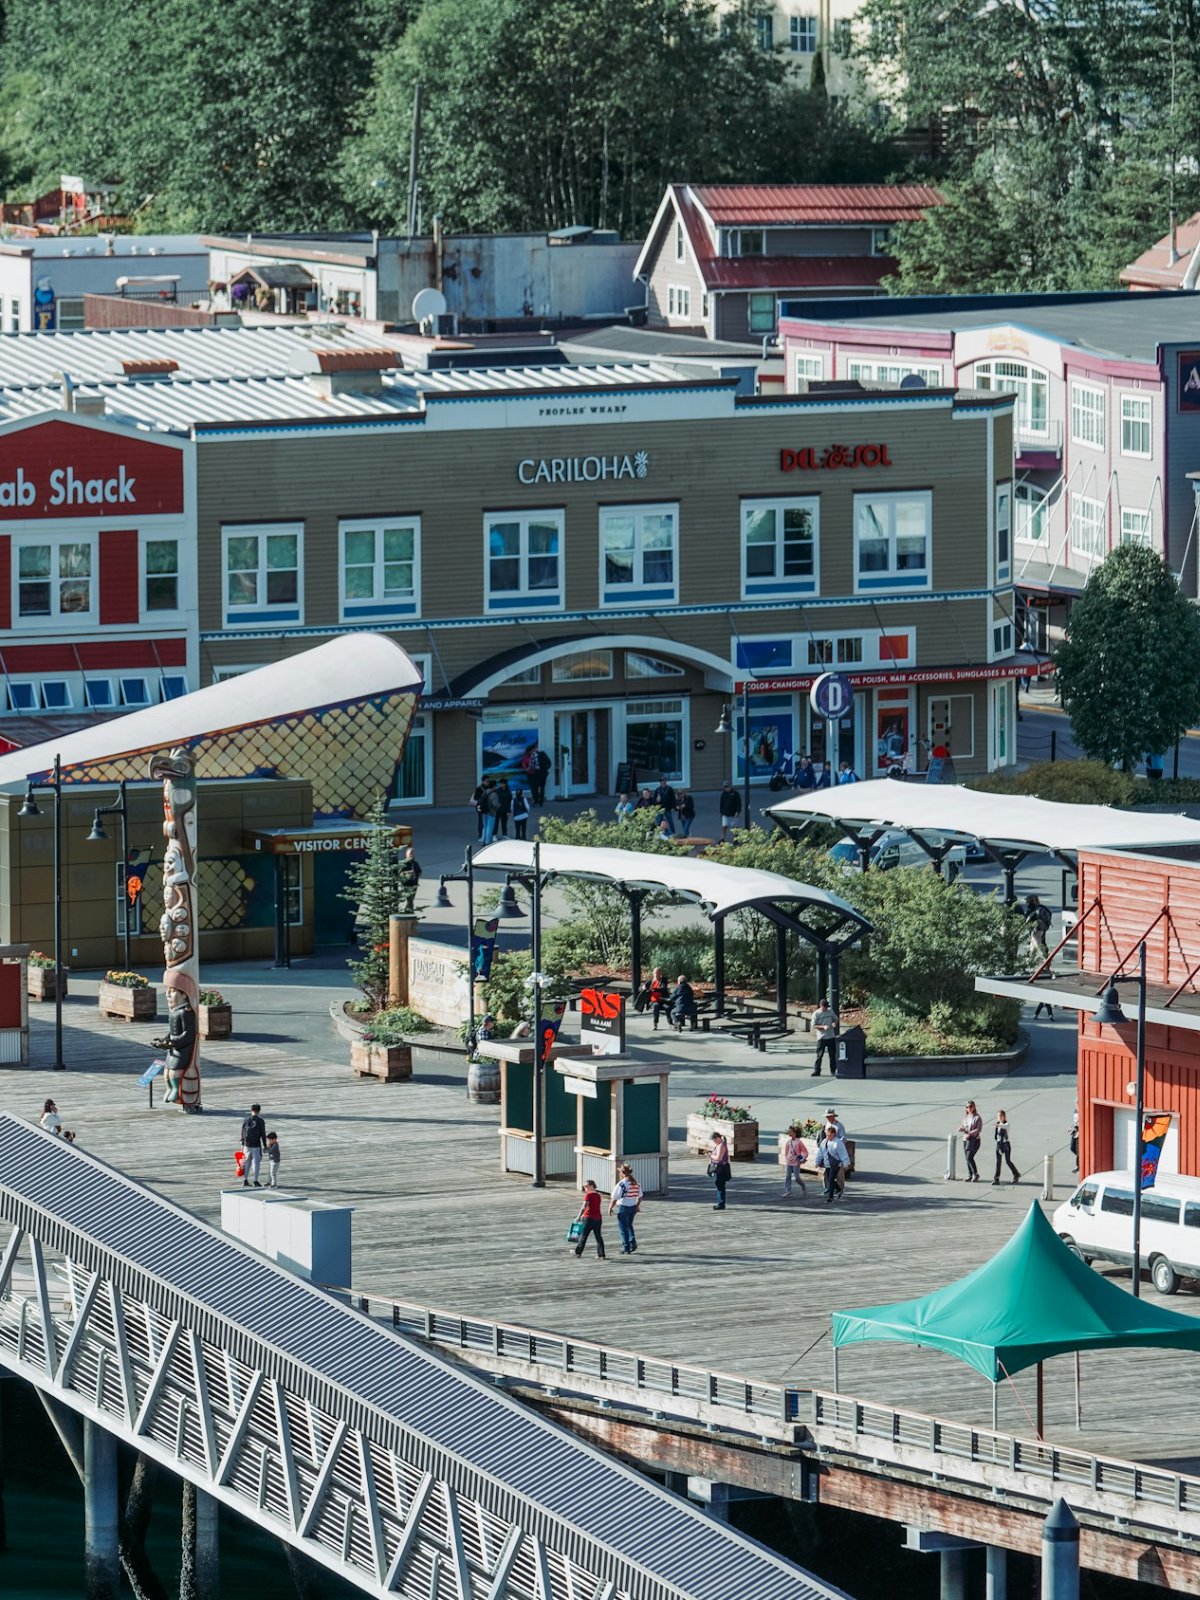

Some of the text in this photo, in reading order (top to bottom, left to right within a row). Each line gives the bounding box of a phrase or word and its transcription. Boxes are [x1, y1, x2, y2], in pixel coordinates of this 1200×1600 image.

[590, 405, 627, 413] WHARF
[780, 443, 893, 472] DEL SOL
[518, 454, 635, 484] CARILOHA
[49, 465, 136, 506] Shack
[863, 676, 888, 684] POLISH,
[908, 672, 954, 682] ACCESSORIES,
[957, 670, 999, 679] SUNGLASSES
[1008, 668, 1027, 676] MORE
[424, 699, 483, 709] AND APPAREL
[828, 682, 842, 711] D
[294, 839, 340, 852] VISITOR
